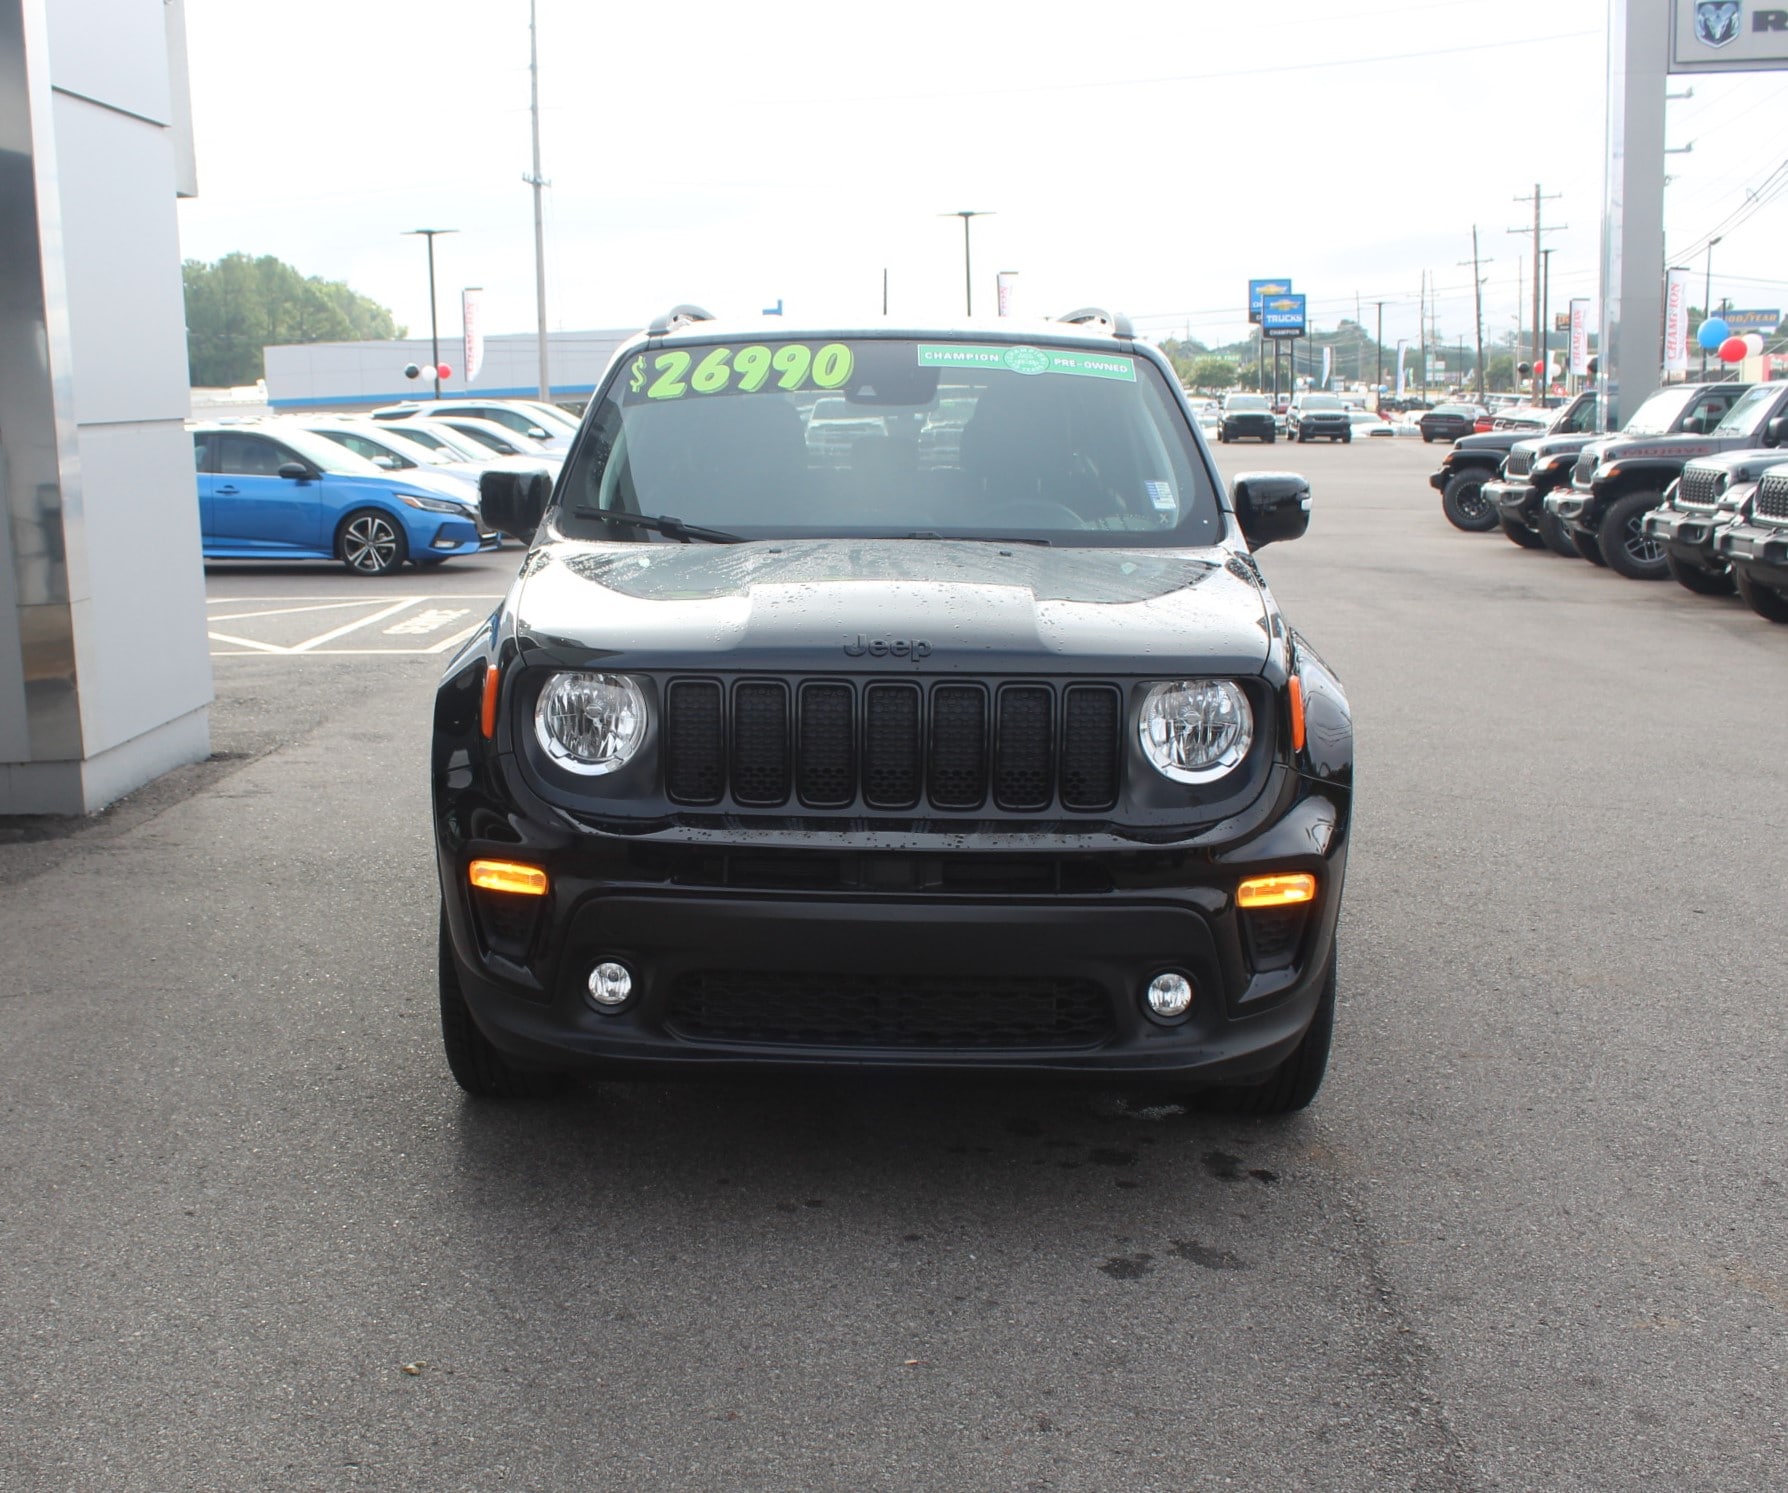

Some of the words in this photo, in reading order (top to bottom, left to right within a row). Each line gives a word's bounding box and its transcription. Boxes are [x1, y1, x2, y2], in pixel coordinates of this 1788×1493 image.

[1266, 314, 1303, 323] TRUCKS
[1667, 283, 1680, 360] CHAMION
[924, 350, 1000, 362] CHAMPION
[1054, 358, 1129, 374] PRE-OWNED
[1623, 447, 1710, 457] MOJAVE
[843, 633, 933, 662] Jeep
